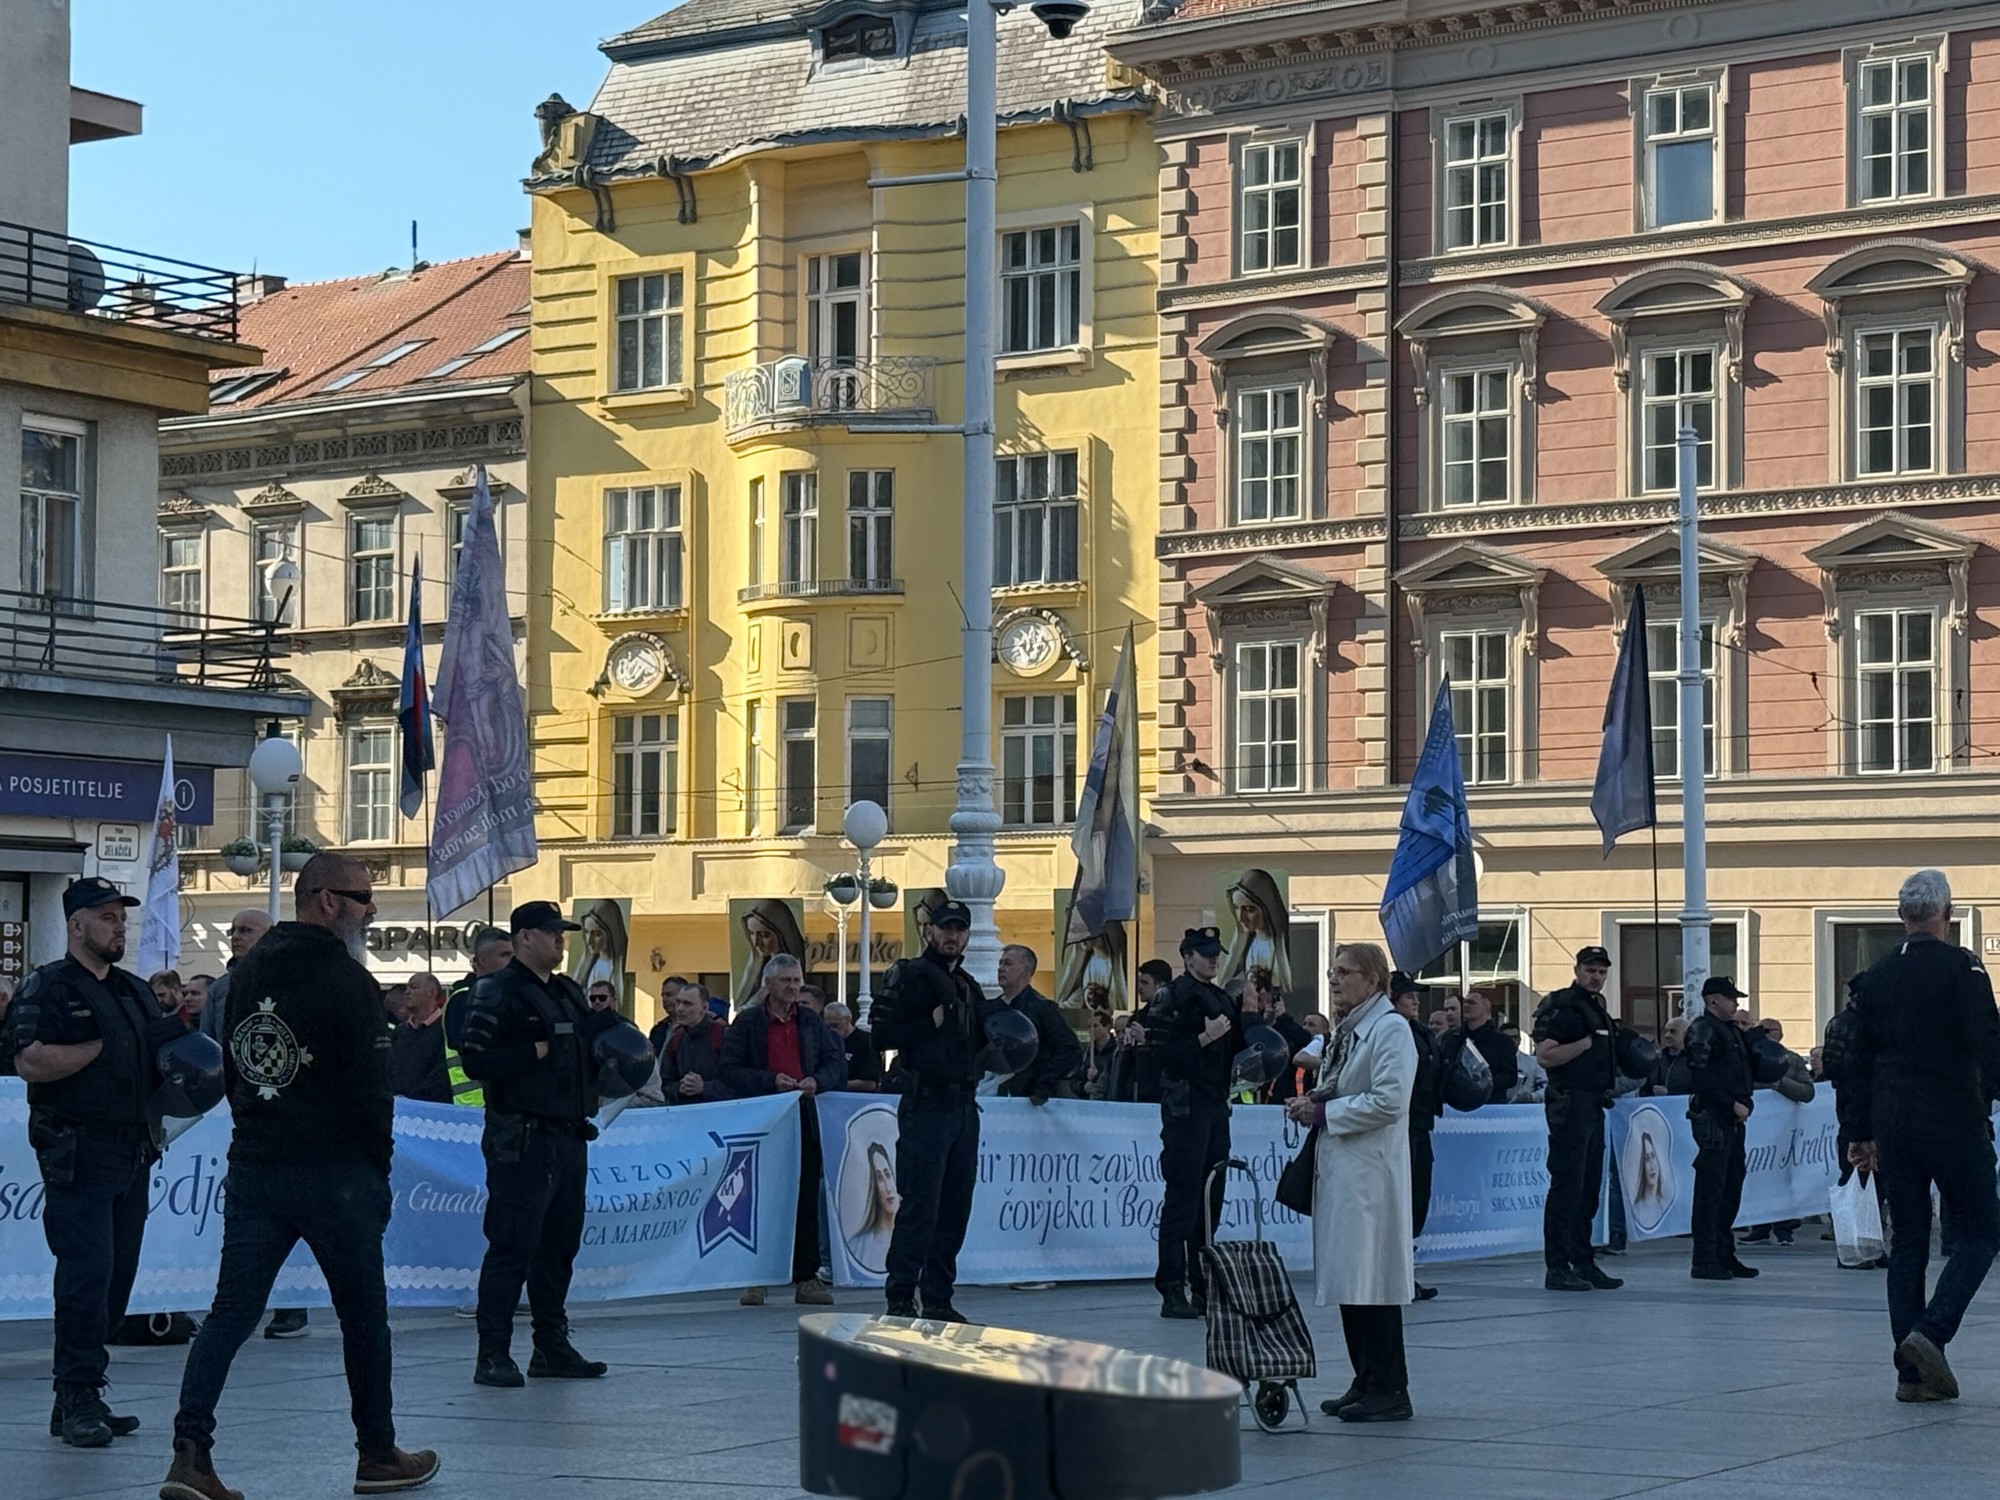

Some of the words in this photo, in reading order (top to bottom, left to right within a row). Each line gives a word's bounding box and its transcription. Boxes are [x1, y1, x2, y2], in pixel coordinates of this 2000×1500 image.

[10, 776, 122, 799] POSJETITELJE
[588, 1157, 708, 1185] TEZOVI
[979, 1140, 1001, 1183] ir
[1008, 1152, 1081, 1184] mora
[1000, 1185, 1096, 1245] čovjeka
[1103, 1187, 1110, 1228] i
